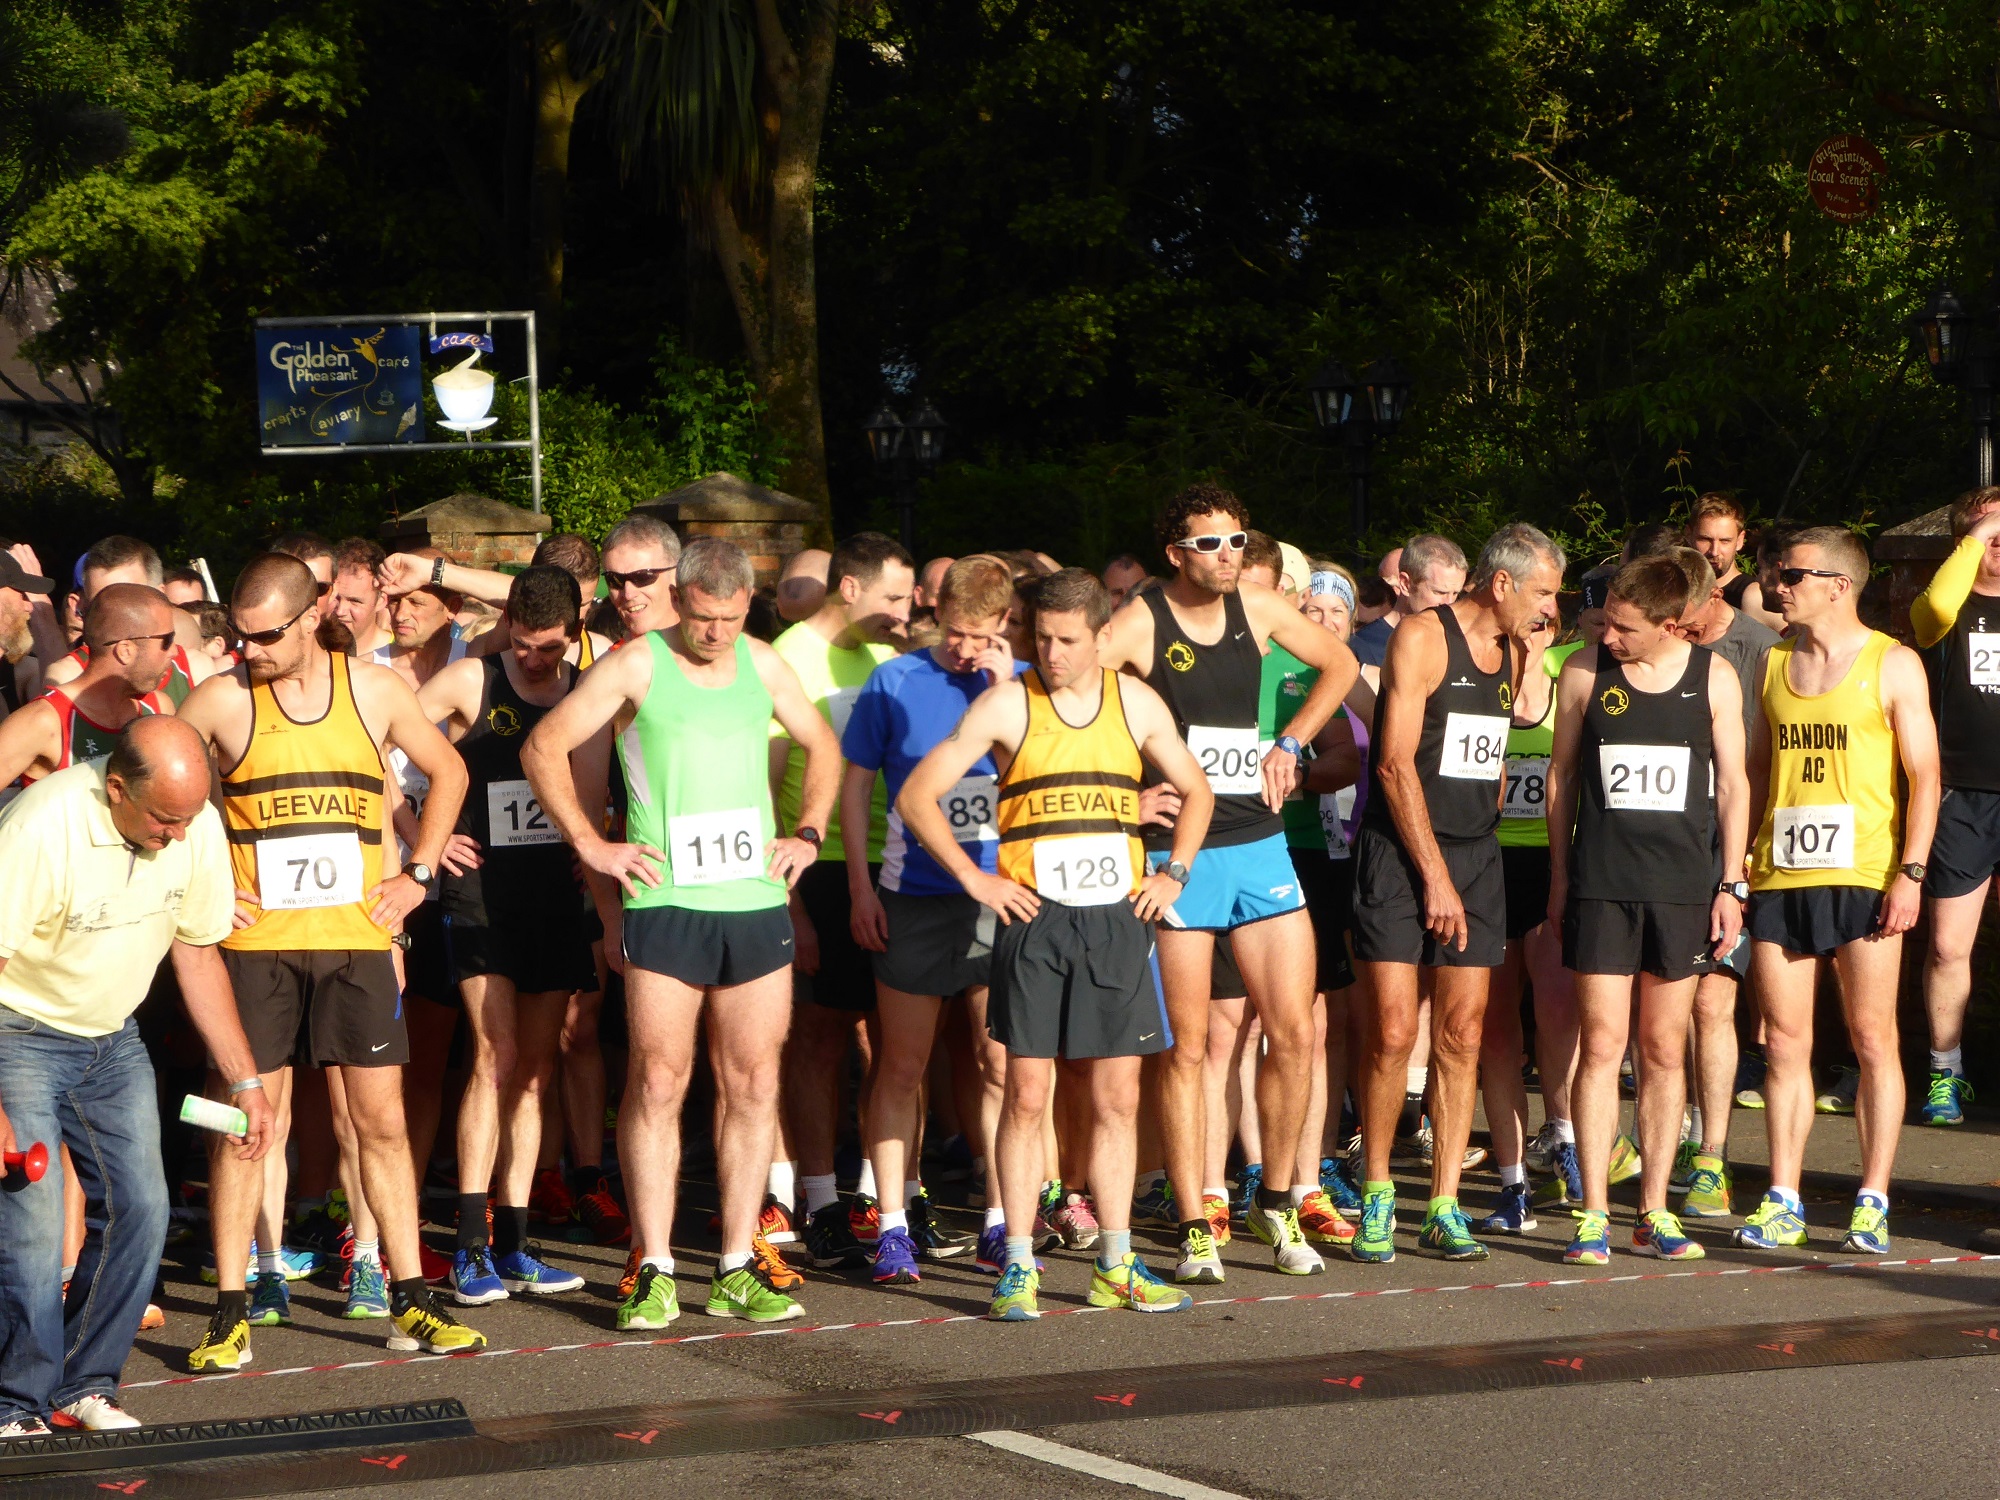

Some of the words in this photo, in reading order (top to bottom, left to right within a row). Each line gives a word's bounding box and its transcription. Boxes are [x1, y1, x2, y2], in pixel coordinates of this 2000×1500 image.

[1816, 137, 1848, 164] Original
[1811, 170, 1834, 184] Local
[1840, 173, 1868, 186] Scenes
[270, 341, 349, 395] Golden
[296, 367, 358, 381] Pheasant
[378, 356, 410, 369] café
[263, 405, 306, 430] crafts
[318, 406, 360, 429] aviary
[1459, 734, 1502, 765] 184
[1778, 723, 1848, 750] BANDON
[1201, 747, 1258, 777] 209
[1802, 756, 1825, 783] AC
[1506, 775, 1545, 804] 78
[1610, 763, 1676, 794] 210
[258, 794, 368, 822] LEEVALE
[1028, 792, 1131, 817] LEEVALE
[687, 830, 752, 867] 116
[1785, 824, 1840, 853] 107
[286, 856, 337, 892] 70
[1053, 856, 1120, 891] 128
